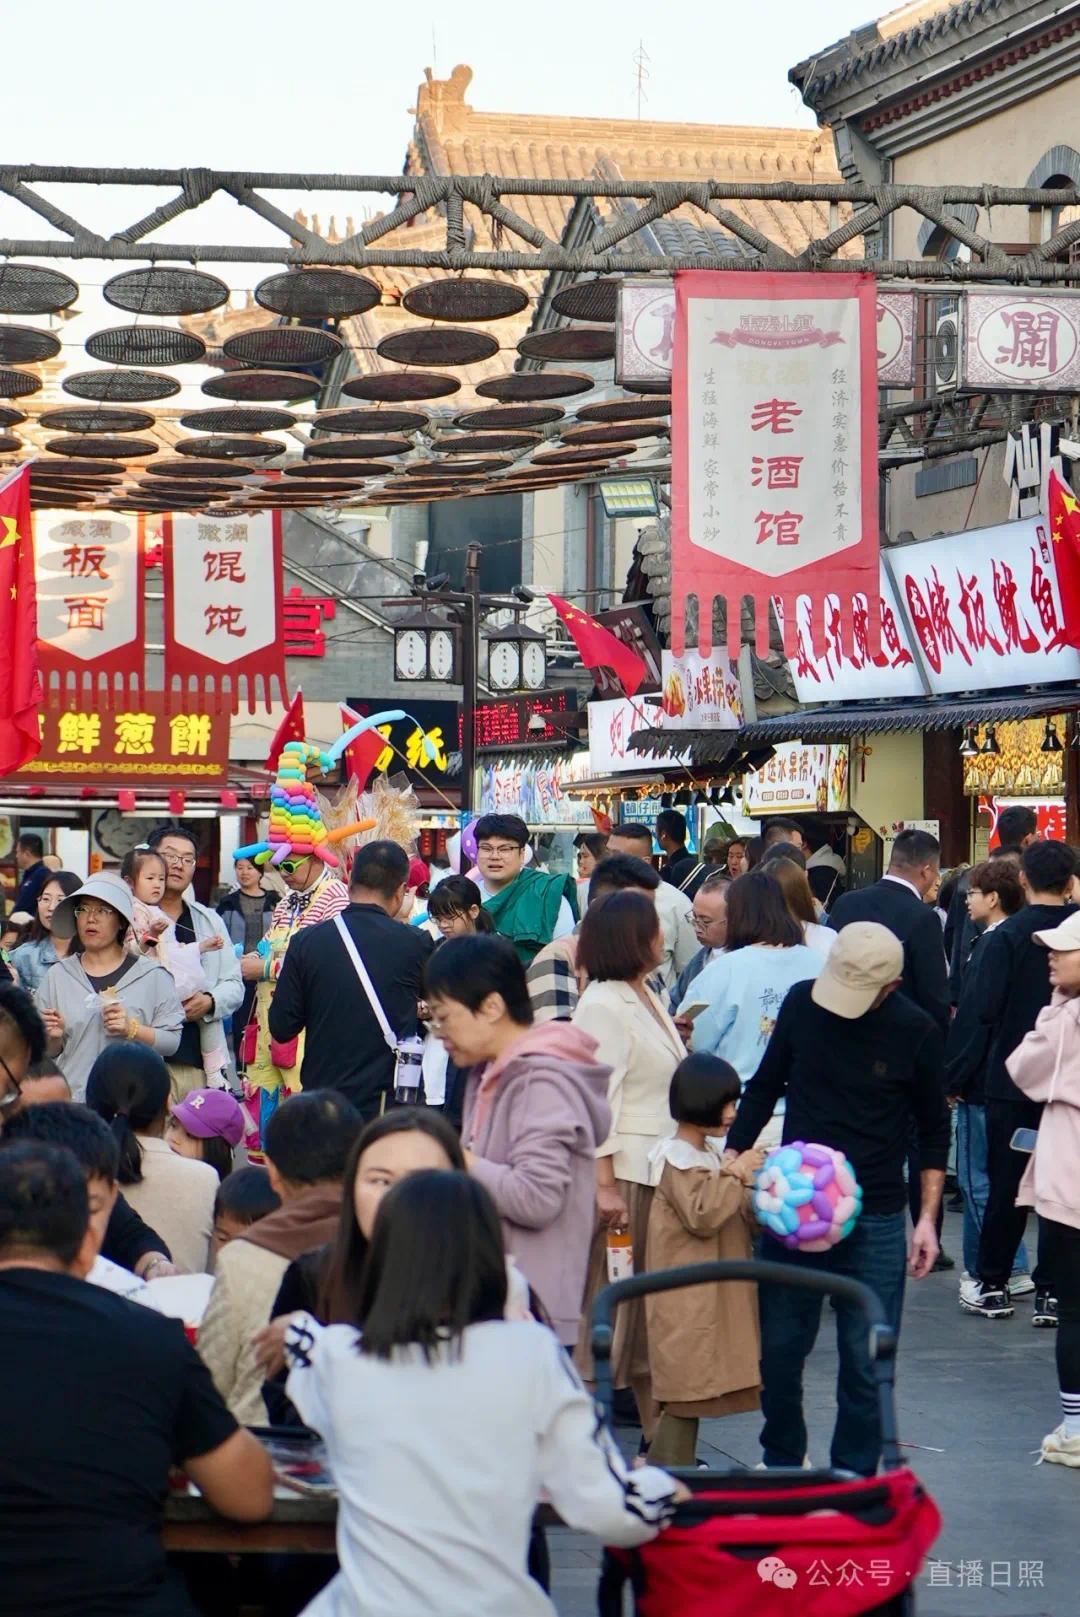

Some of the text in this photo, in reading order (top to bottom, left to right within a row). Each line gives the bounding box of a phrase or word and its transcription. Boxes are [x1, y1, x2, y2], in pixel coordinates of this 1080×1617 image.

[751, 398, 804, 546] 老酒馆
[62, 543, 110, 631] 板面
[203, 551, 248, 638] 馄饨
[38, 712, 212, 756] 鮮葱餅
[190, 1095, 205, 1110] R
